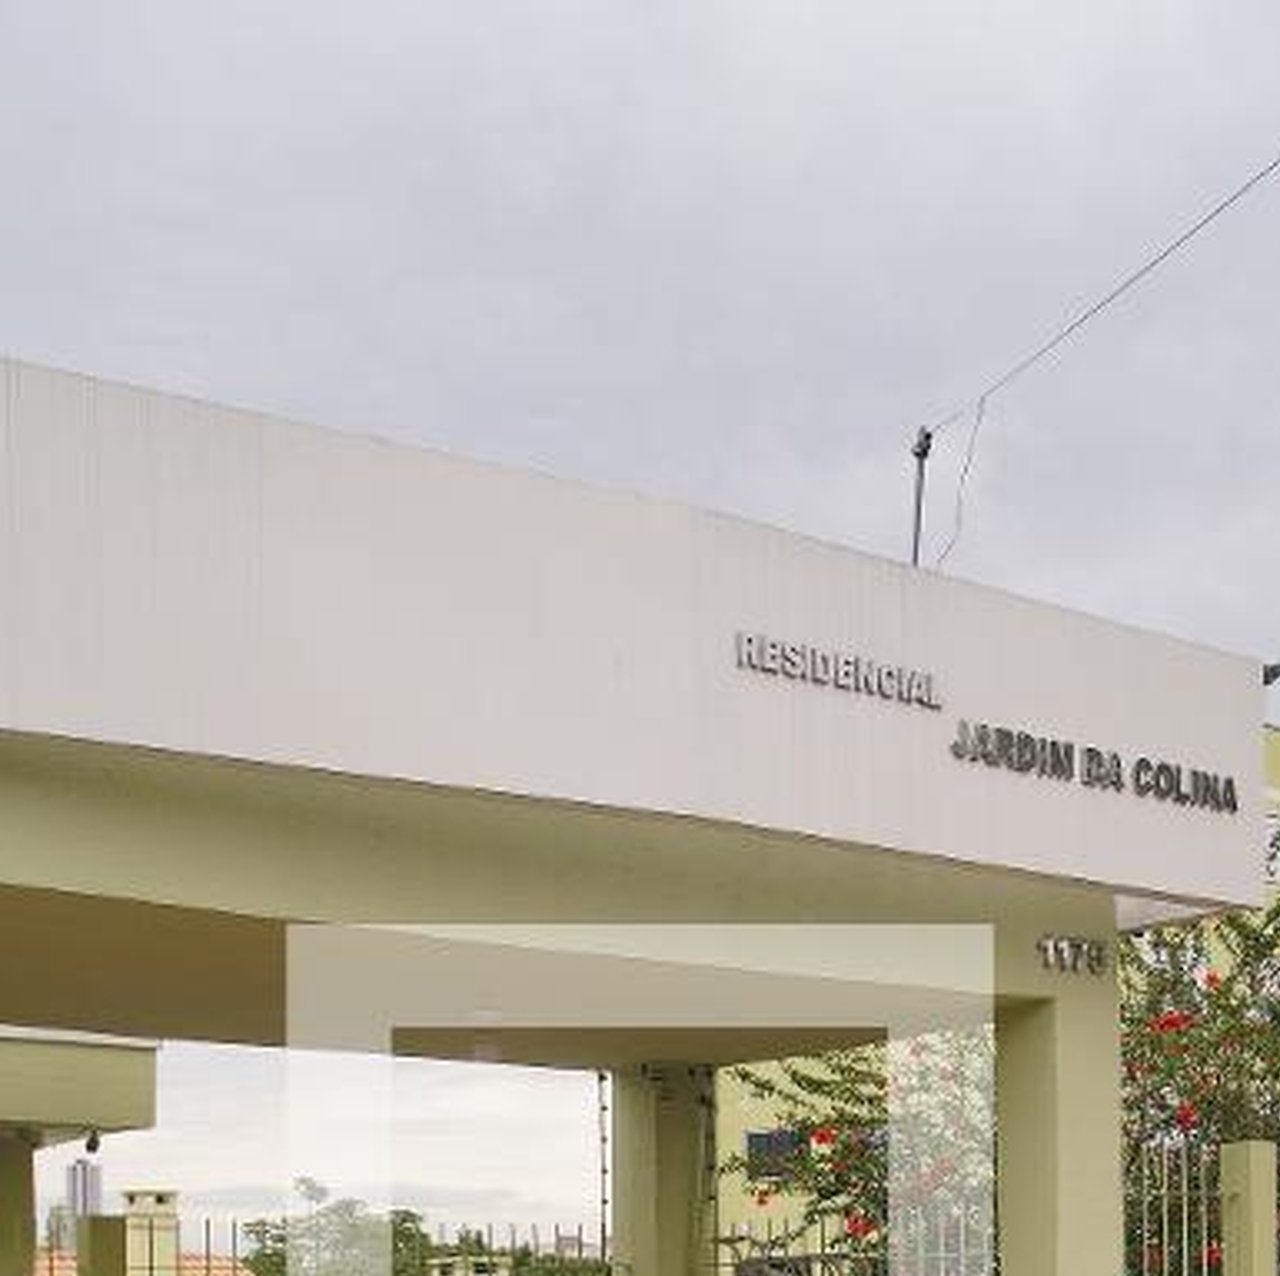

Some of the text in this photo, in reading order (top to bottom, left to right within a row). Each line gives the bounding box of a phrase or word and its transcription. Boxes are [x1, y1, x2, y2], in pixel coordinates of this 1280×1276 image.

[734, 630, 942, 711] RESIDENCIAL
[1080, 746, 1124, 793] DA
[1131, 757, 1238, 815] COLINA
